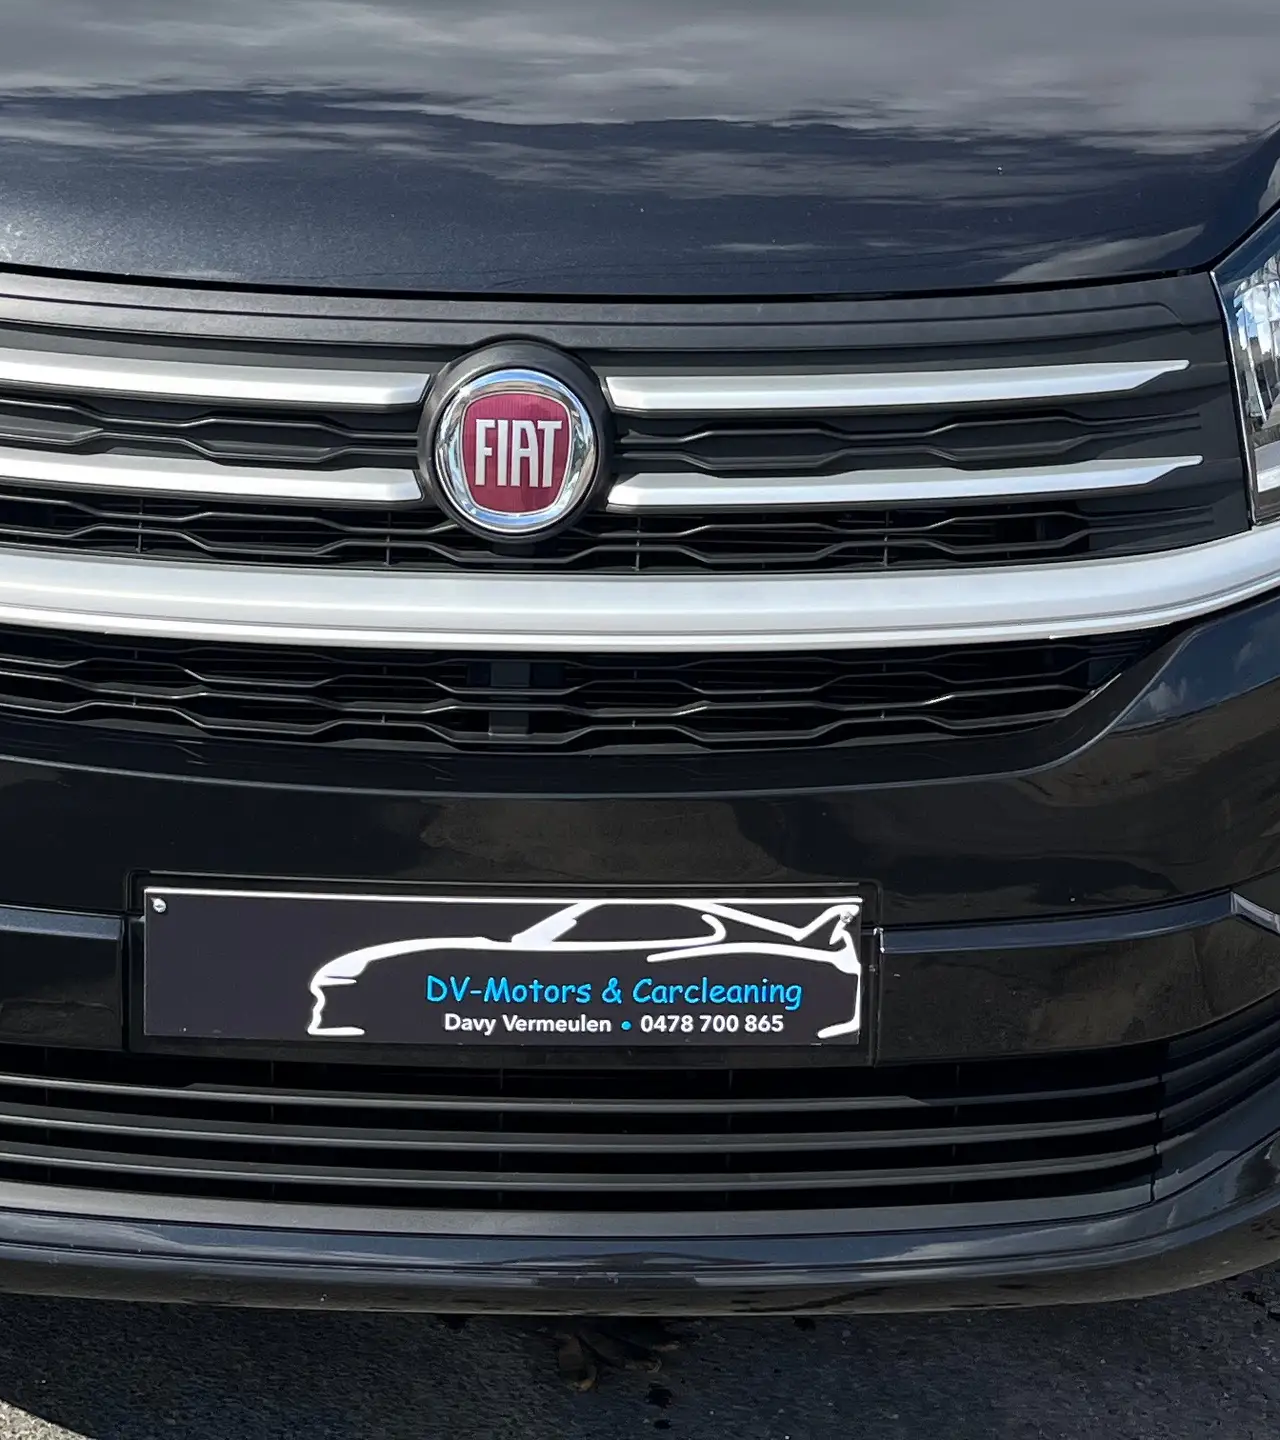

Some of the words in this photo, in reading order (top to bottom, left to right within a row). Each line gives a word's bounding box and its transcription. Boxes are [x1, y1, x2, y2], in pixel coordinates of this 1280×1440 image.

[475, 419, 562, 488] FIAT
[426, 975, 592, 1003] DV-Motors
[602, 977, 622, 1004] &
[632, 977, 802, 1011] Carcleaning
[444, 1013, 496, 1036] Davy
[502, 1014, 612, 1032] Vermeulen
[640, 1014, 694, 1033] 0478
[699, 1014, 739, 1033] 700
[744, 1014, 784, 1033] 865
